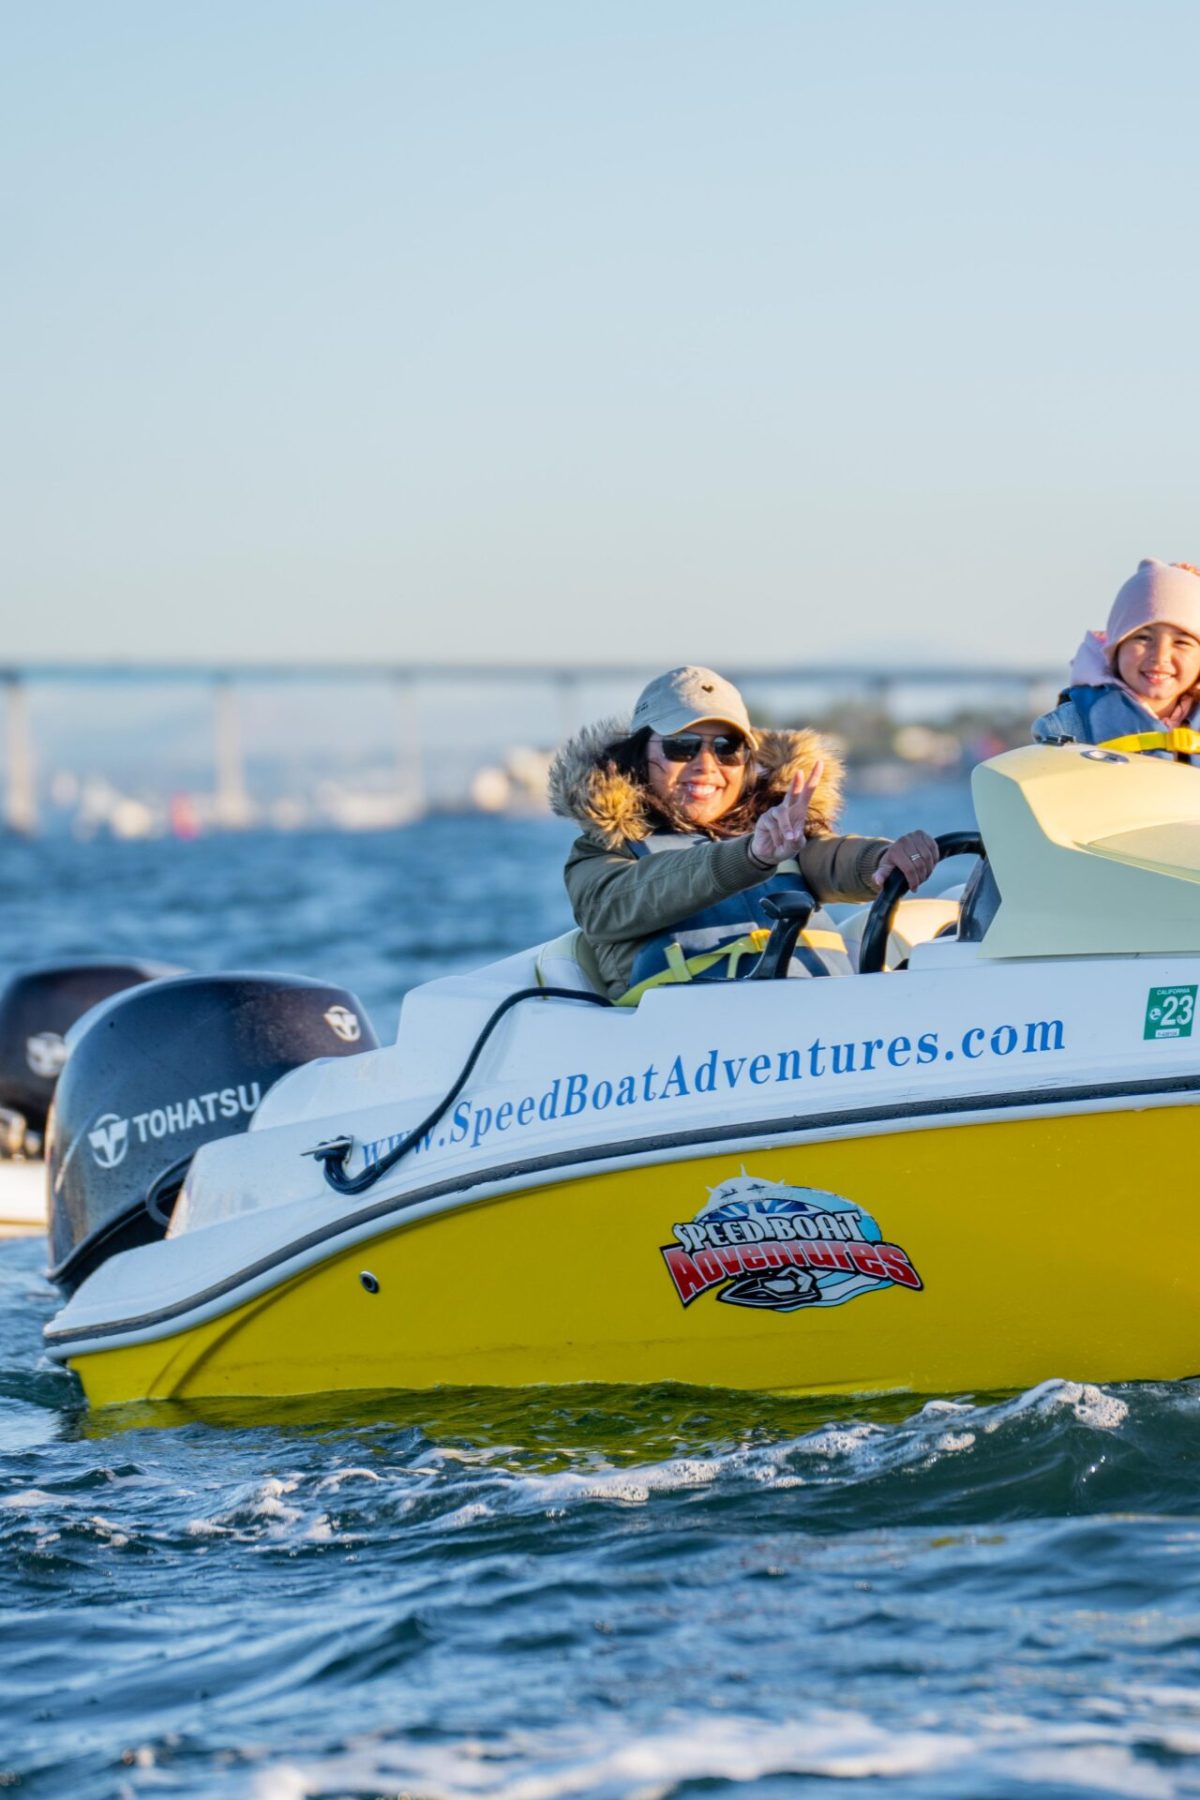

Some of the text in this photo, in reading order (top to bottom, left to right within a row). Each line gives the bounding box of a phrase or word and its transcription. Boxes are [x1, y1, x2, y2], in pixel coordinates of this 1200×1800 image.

[1160, 995, 1194, 1026] 23
[132, 1081, 261, 1143] TOHATSU
[672, 1211, 862, 1252] SPEED BOAT
[662, 1239, 924, 1304] Adventures
